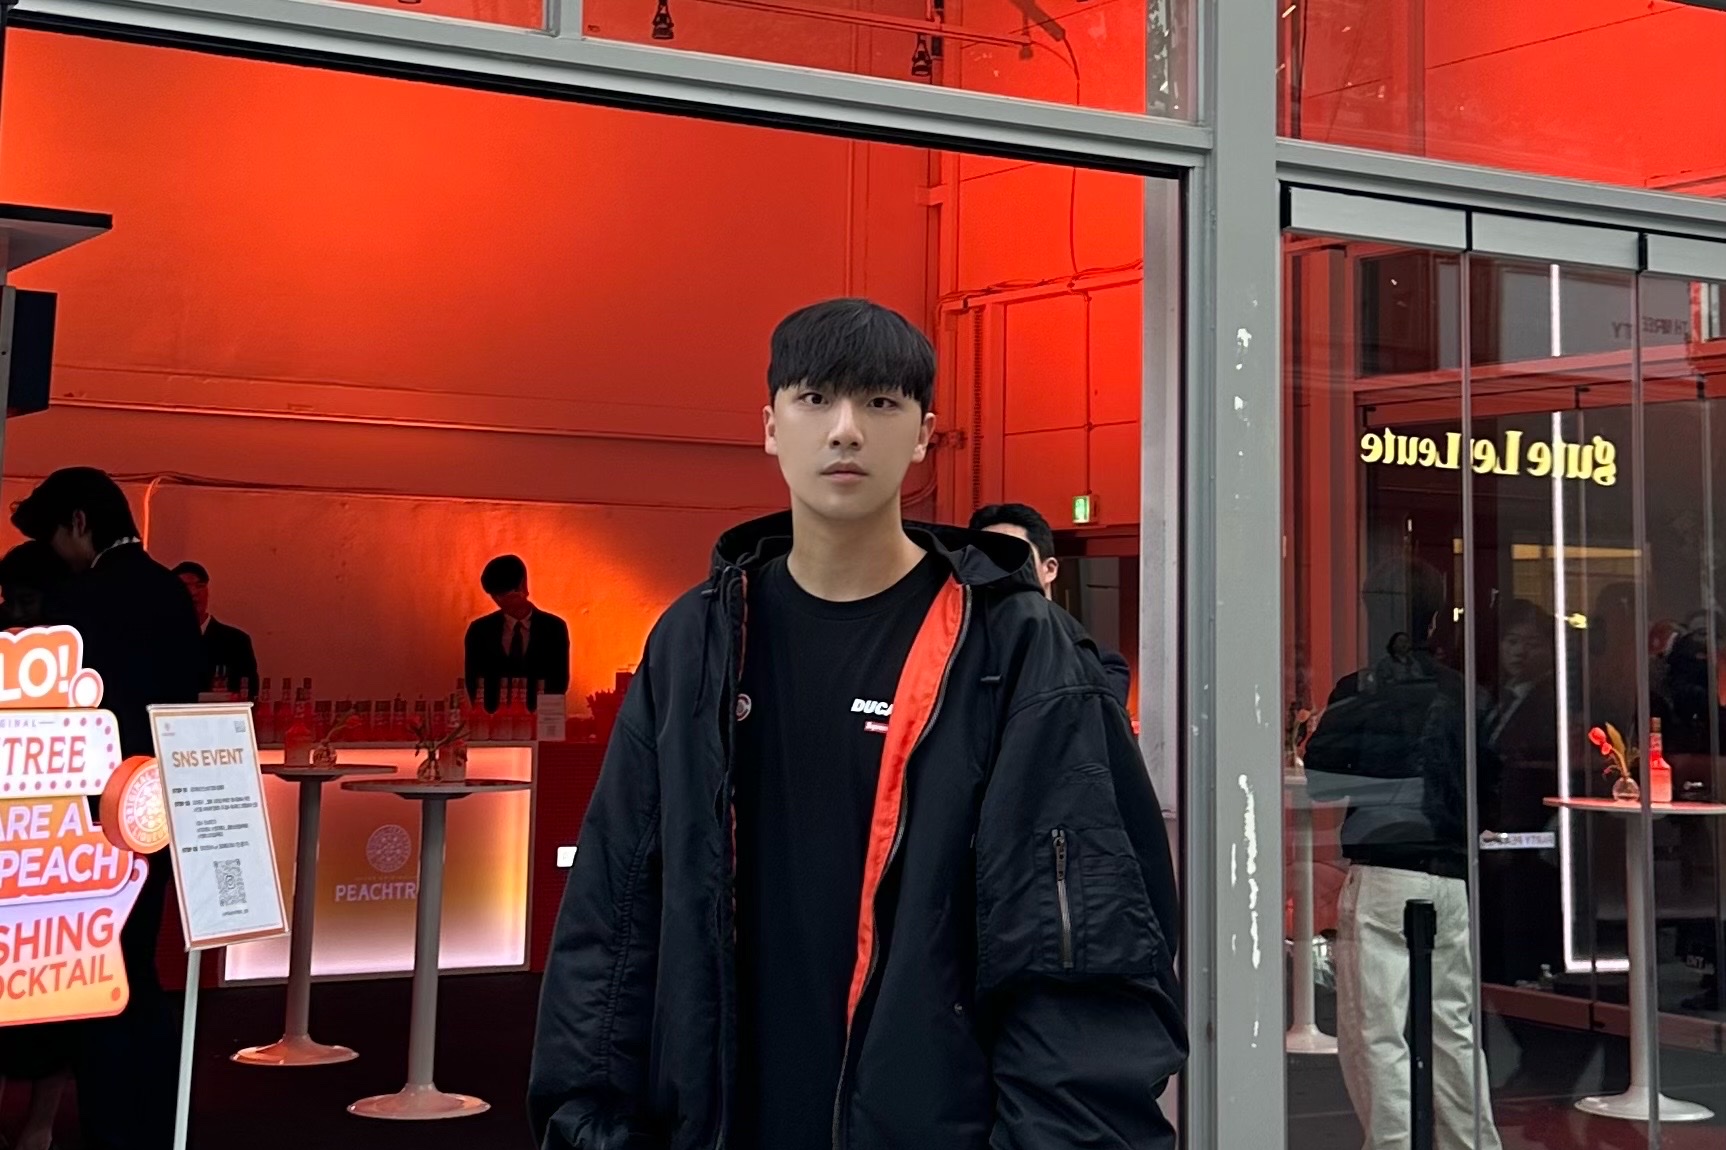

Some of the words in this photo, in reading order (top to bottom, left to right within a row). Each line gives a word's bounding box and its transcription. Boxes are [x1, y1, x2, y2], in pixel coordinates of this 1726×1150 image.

[172, 750, 199, 768] SNS
[201, 748, 243, 766] EVENT
[0, 804, 52, 841] RE
[0, 843, 116, 888] PEACH
[0, 954, 113, 1001] CKTAIL
